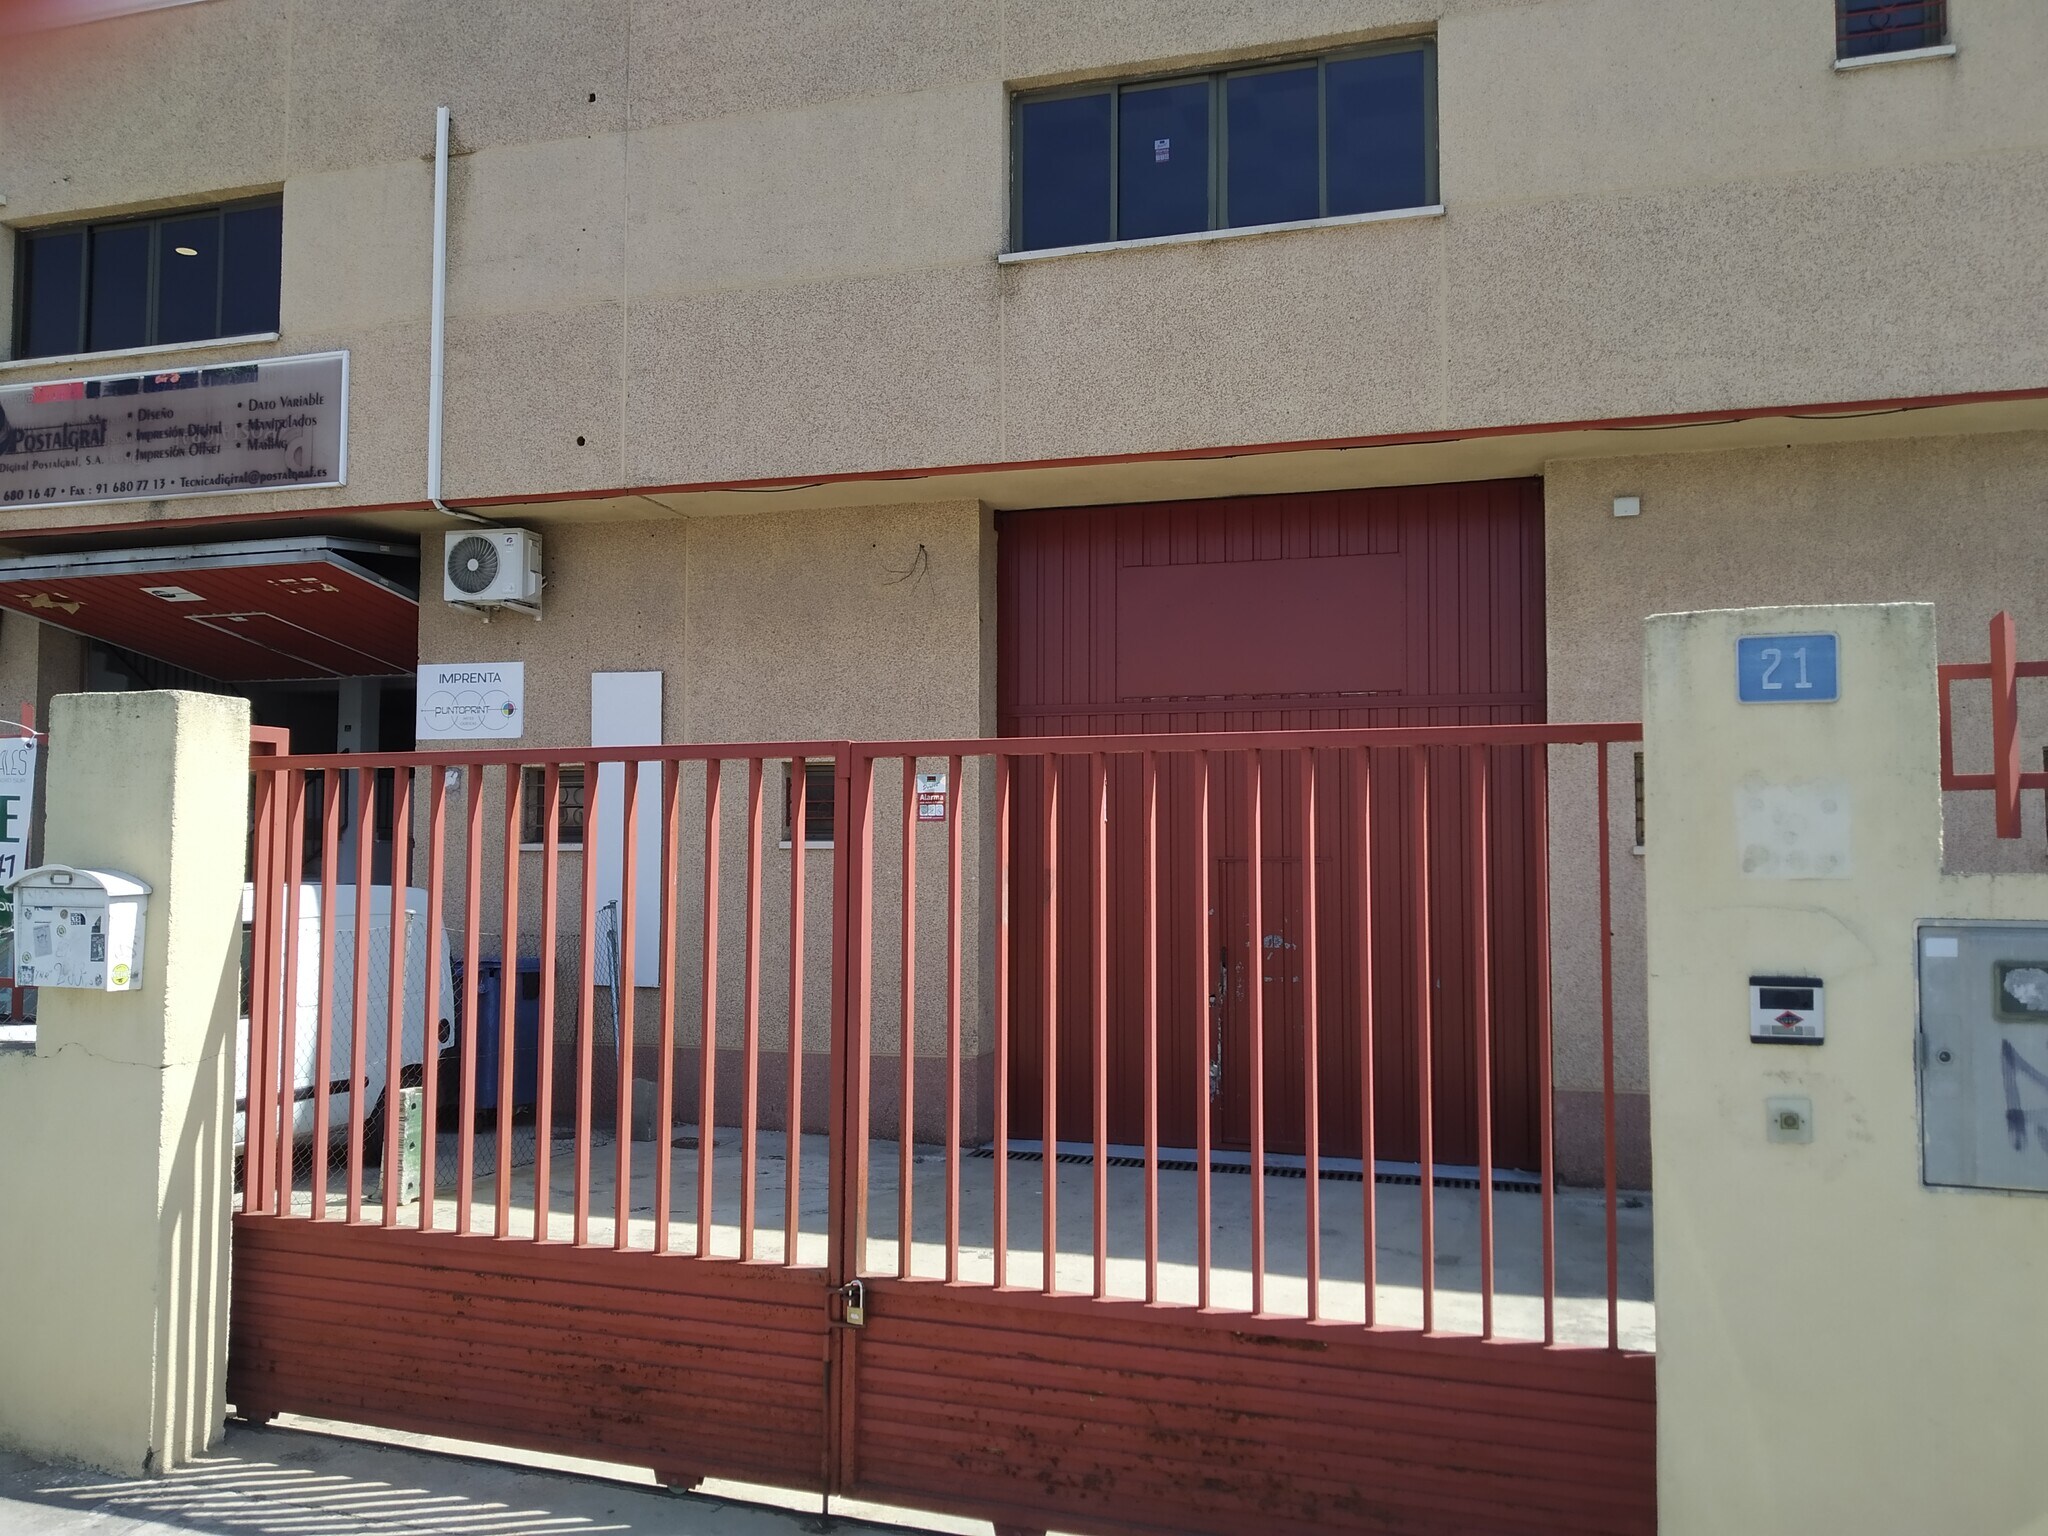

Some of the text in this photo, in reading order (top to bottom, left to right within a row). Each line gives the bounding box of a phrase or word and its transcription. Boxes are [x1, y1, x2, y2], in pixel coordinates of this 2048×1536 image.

[4, 490, 24, 501] 680
[28, 488, 40, 499] 16
[44, 487, 56, 498] 47
[96, 483, 108, 494] 91
[113, 481, 133, 493] 680
[137, 480, 149, 491] 77
[154, 478, 166, 490] 13
[438, 672, 502, 684] IMPRENTA
[1761, 647, 1813, 690] 21
